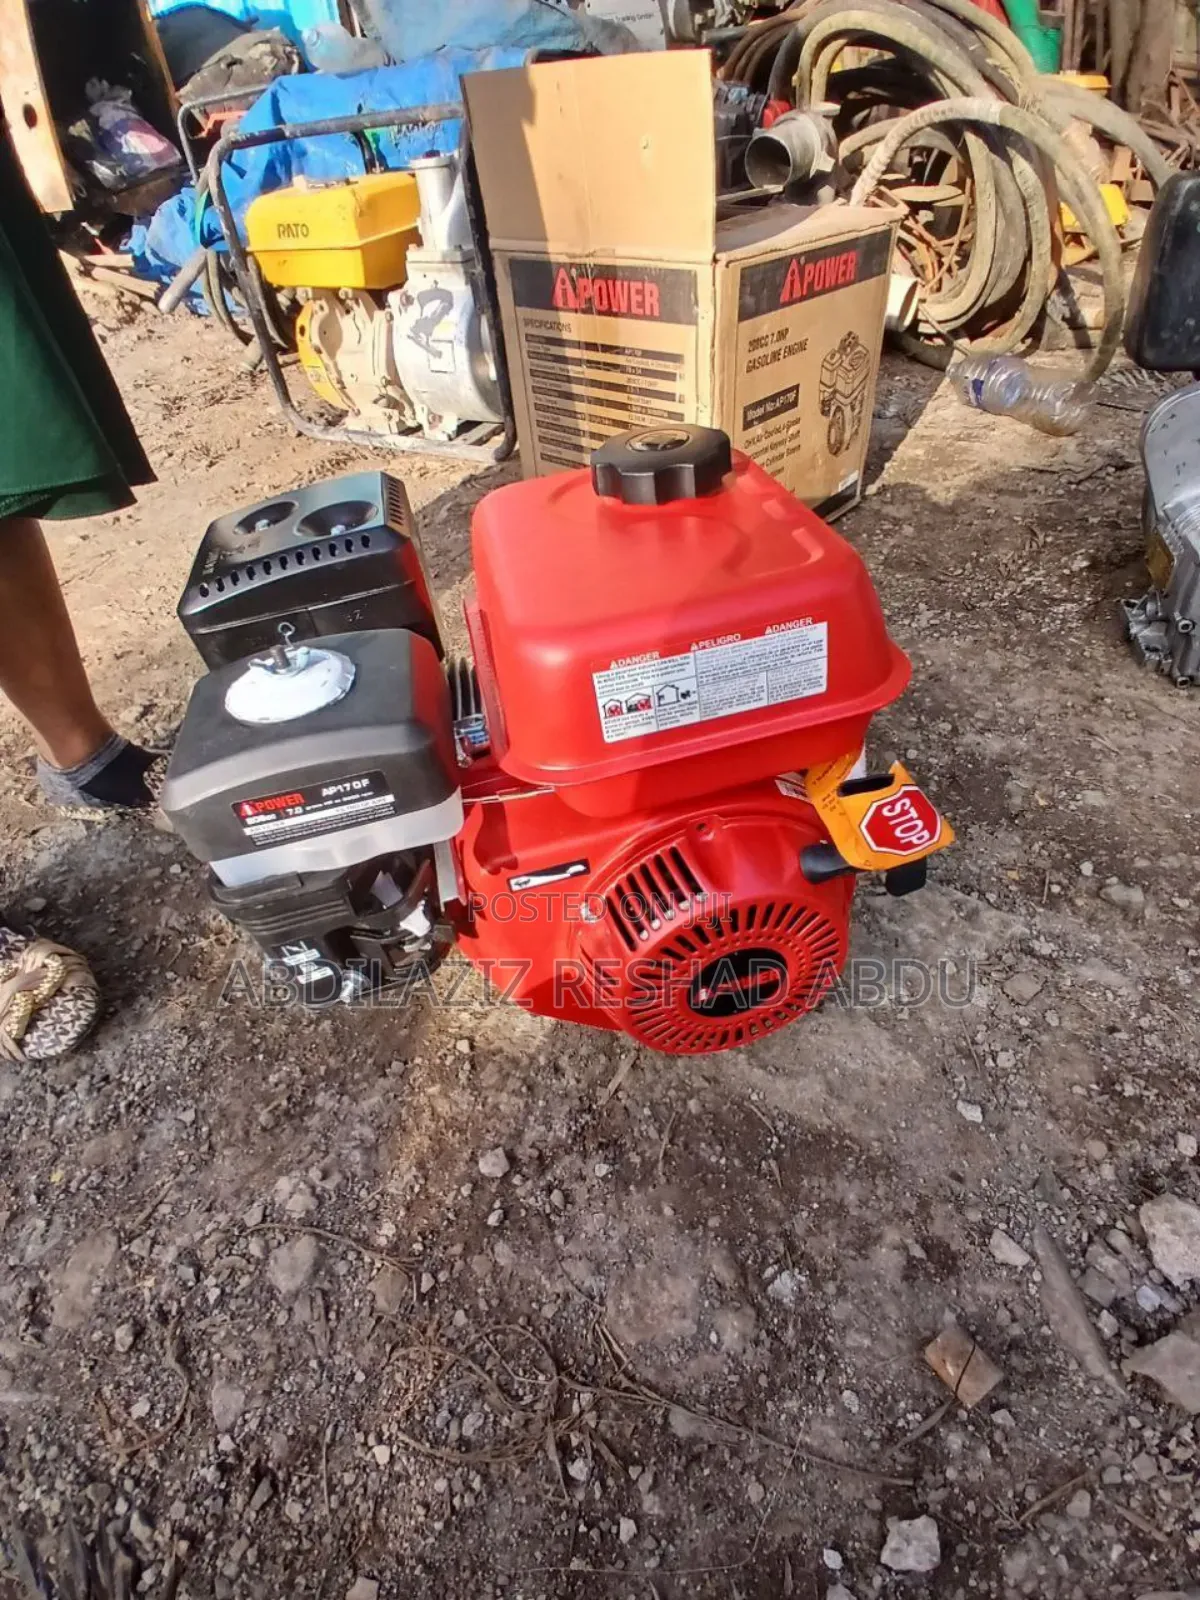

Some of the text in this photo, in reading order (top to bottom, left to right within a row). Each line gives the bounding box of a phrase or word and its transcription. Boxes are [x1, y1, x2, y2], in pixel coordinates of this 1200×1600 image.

[523, 317, 573, 333] SPECIFICATIONS
[746, 337, 809, 374] GASOLINE ENGINE
[772, 616, 813, 634] DANGER
[698, 633, 742, 649] PELIGRO
[618, 651, 661, 667] DANGER
[321, 778, 371, 798] AP170F
[881, 797, 931, 845] STOP
